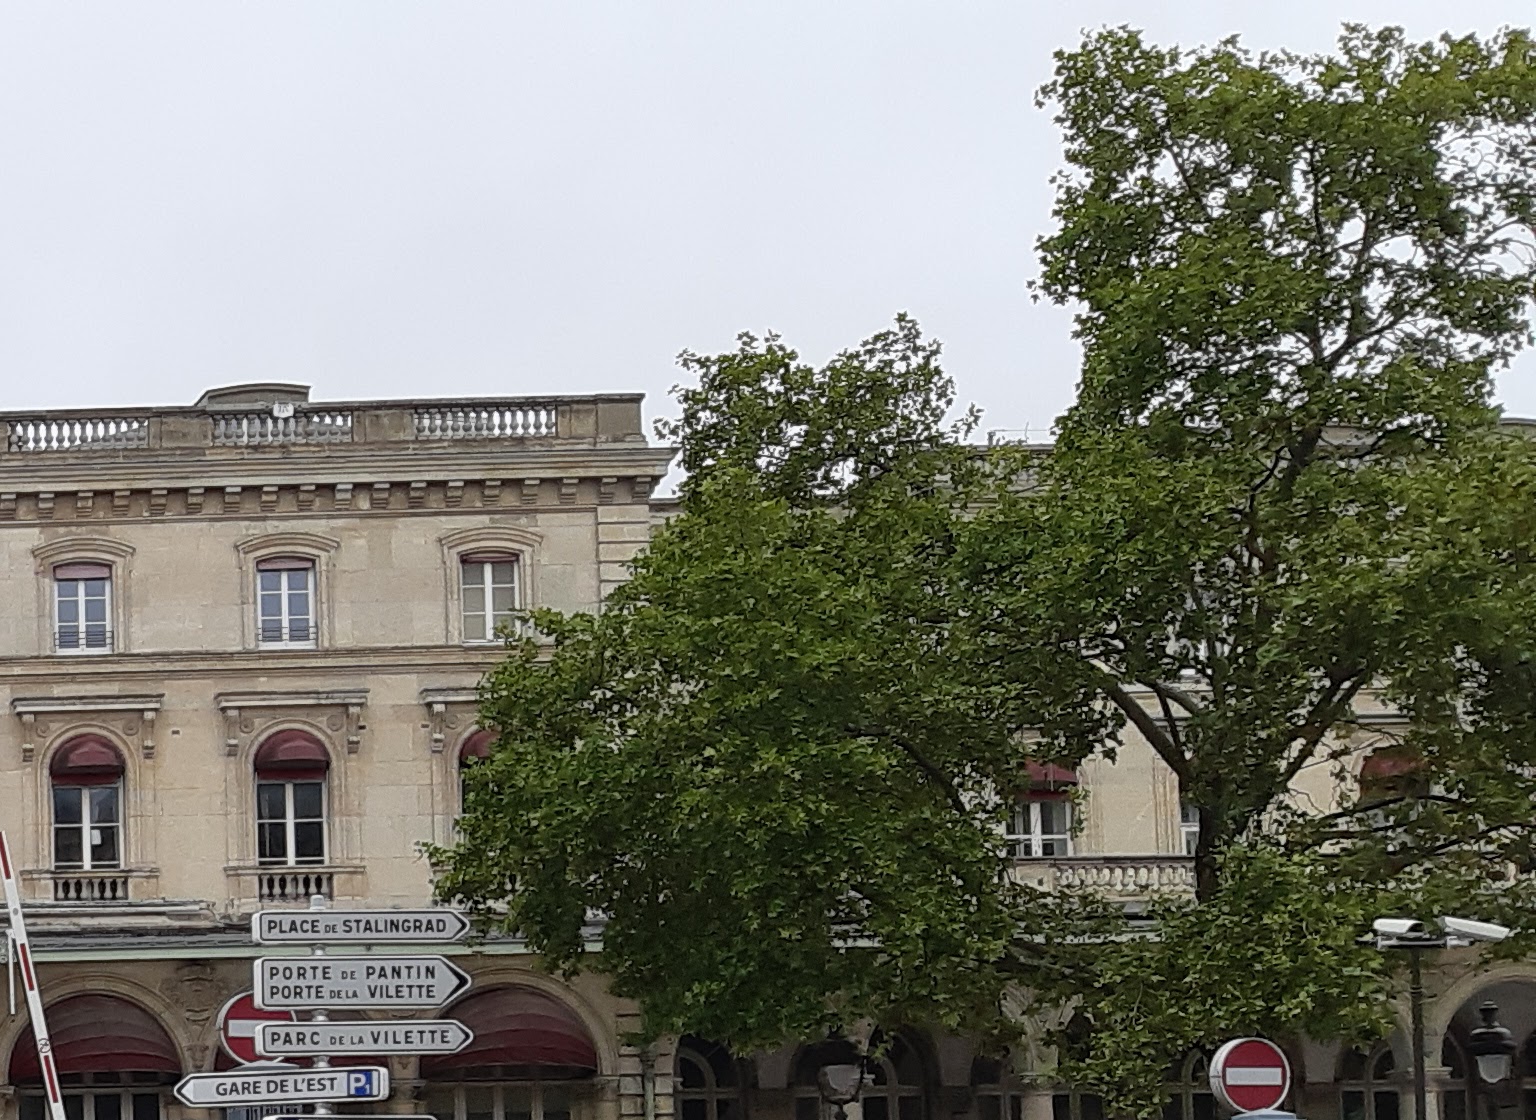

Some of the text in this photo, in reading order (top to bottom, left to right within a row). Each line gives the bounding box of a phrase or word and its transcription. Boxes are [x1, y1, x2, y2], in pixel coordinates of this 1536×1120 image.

[267, 918, 447, 934] PLACE DE STALINGRAD
[269, 965, 436, 981] PORTE DE PANTIN
[270, 984, 436, 1000] PORTE DE LA VILETTE
[270, 1029, 451, 1046] PARC DE LA VILETTE
[215, 1080, 262, 1097] GARE
[266, 1080, 289, 1094] DE
[293, 1076, 338, 1093] L'EST
